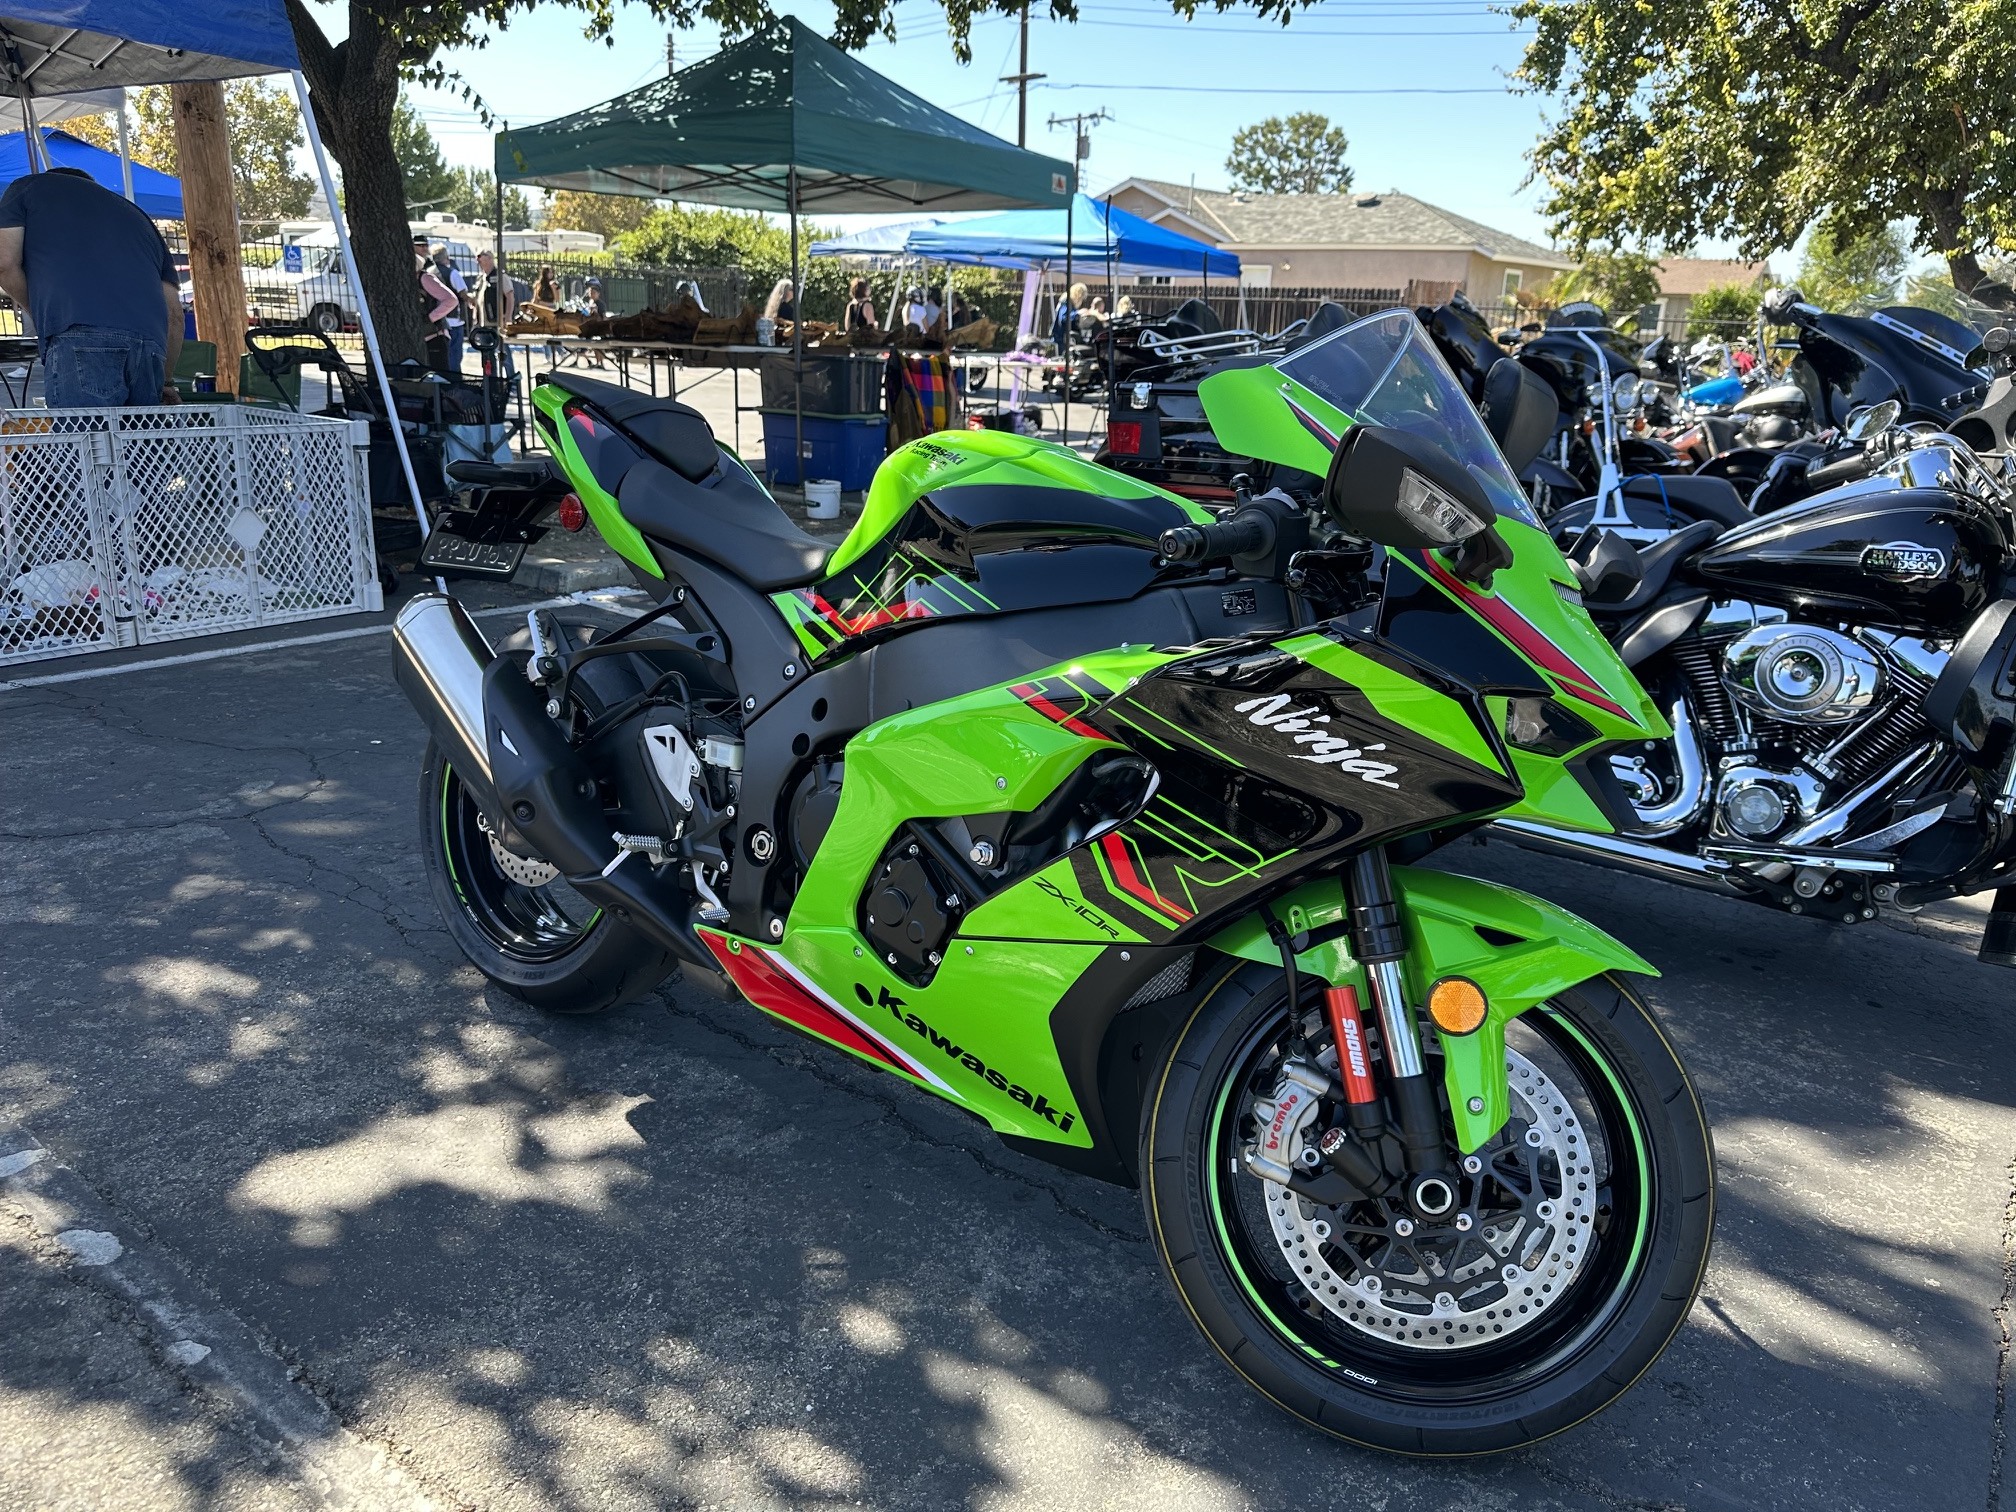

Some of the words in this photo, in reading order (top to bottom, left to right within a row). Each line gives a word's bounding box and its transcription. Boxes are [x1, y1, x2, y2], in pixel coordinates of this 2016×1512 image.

[912, 440, 968, 466] Kawasaki
[1234, 693, 1400, 789] Ninja
[1032, 876, 1120, 941] ZX-10R
[877, 985, 1076, 1134] Kawasaki
[1342, 1017, 1367, 1078] SHOWA
[1266, 1094, 1299, 1150] brembo
[1185, 1138, 1238, 1305] BRIDGESTONE
[1343, 1368, 1379, 1386] 1000
